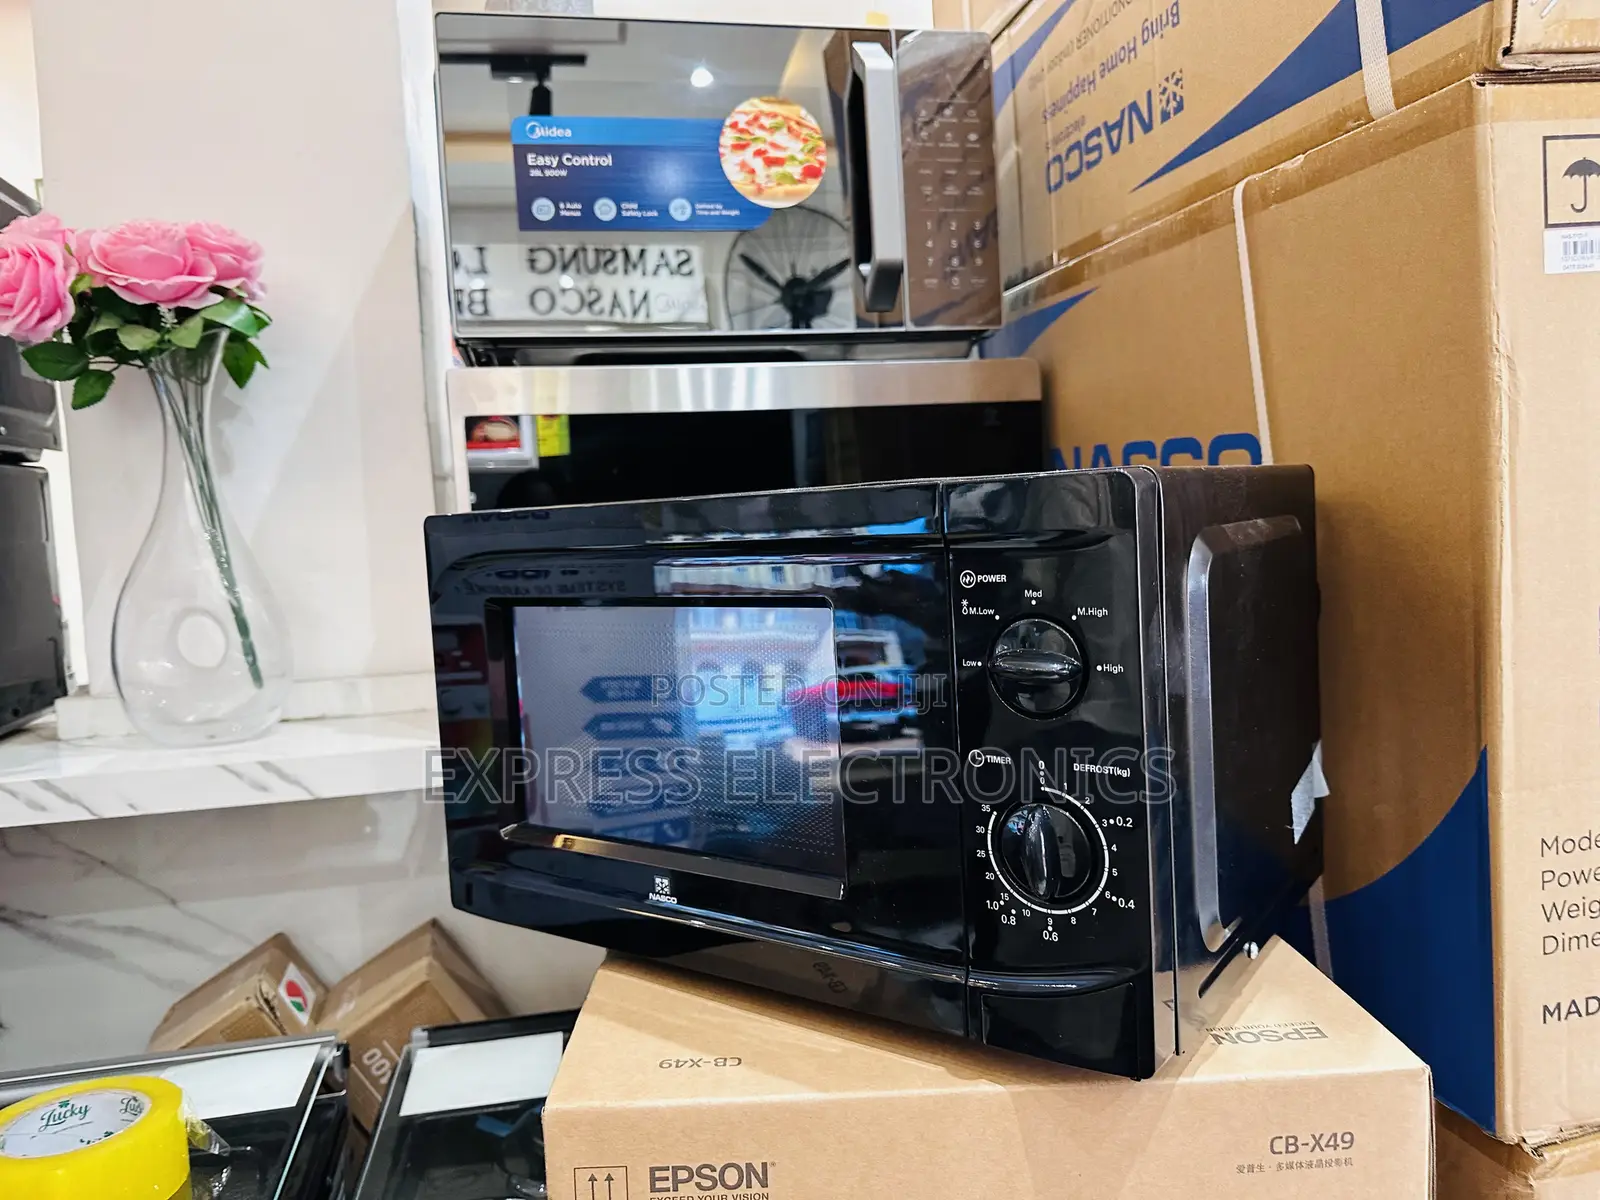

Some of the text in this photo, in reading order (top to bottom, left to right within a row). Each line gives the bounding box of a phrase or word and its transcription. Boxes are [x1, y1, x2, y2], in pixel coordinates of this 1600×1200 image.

[1142, 0, 1180, 46] Bring
[1099, 36, 1138, 80] Home
[526, 121, 573, 140] Midea
[1046, 88, 1154, 194] NASCO
[526, 152, 613, 168] Easy Control
[977, 574, 1007, 583] POWER
[1024, 589, 1043, 598] Med
[969, 607, 995, 616] M.Low
[1077, 607, 1108, 618] M.High
[1103, 663, 1124, 674] High
[985, 754, 1012, 765] TIMER
[1038, 760, 1045, 770] 0
[1039, 776, 1045, 785] 0
[1063, 782, 1068, 790] 1
[1085, 797, 1091, 805] 2
[981, 804, 991, 812] 35
[1102, 818, 1108, 827] 3
[1116, 816, 1133, 828] 0.2
[975, 825, 985, 834] 30
[1111, 843, 1117, 852] 4
[976, 850, 986, 858] 25
[985, 872, 995, 880] 20
[1112, 868, 1118, 876] 5
[648, 892, 678, 905] NASCO
[1000, 893, 1010, 901] 15
[1105, 891, 1111, 899] 6
[986, 900, 999, 911] 1.0
[1118, 899, 1135, 910] 0.4
[1022, 908, 1031, 917] 10
[1091, 907, 1097, 916] 7
[1001, 914, 1016, 926] 0.8
[1047, 917, 1053, 925] 9
[1070, 916, 1077, 925] 8
[1042, 930, 1059, 942] 0.6
[1542, 995, 1600, 1025] MAD
[1209, 1026, 1328, 1045] EPSON
[658, 1056, 743, 1069] CB-X49
[38, 1102, 92, 1133] Lucky
[1269, 1131, 1355, 1155] CB-X49
